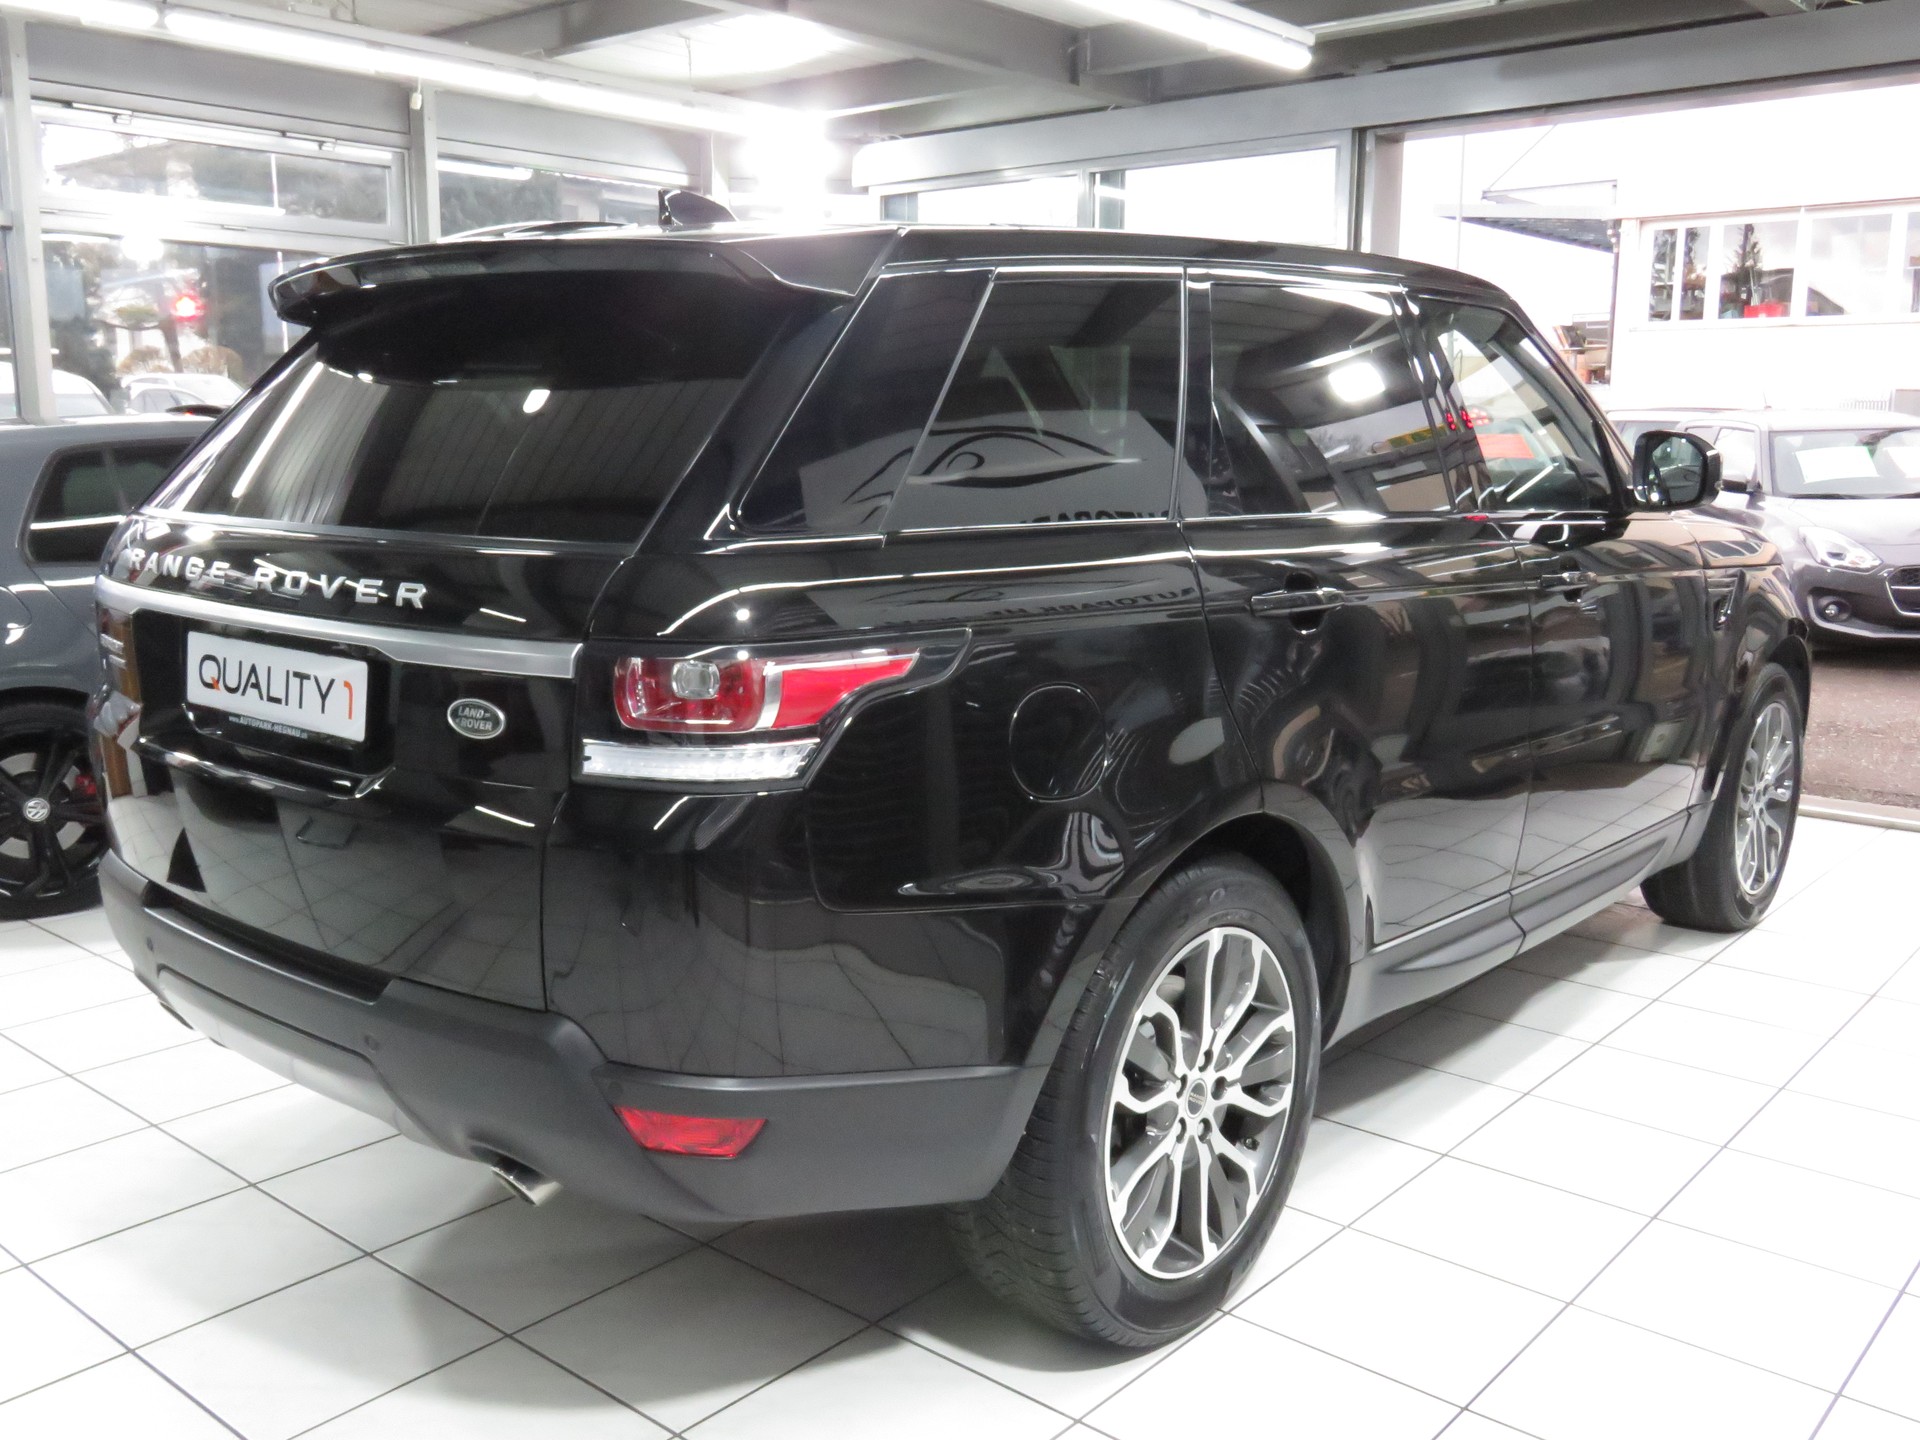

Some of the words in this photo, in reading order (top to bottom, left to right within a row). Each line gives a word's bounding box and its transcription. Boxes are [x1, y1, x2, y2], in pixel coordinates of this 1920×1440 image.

[128, 548, 230, 585] RANGE
[253, 566, 428, 609] ROVER
[198, 653, 336, 715] QUALITY
[458, 706, 485, 719] LAND
[460, 717, 493, 731] ROVER
